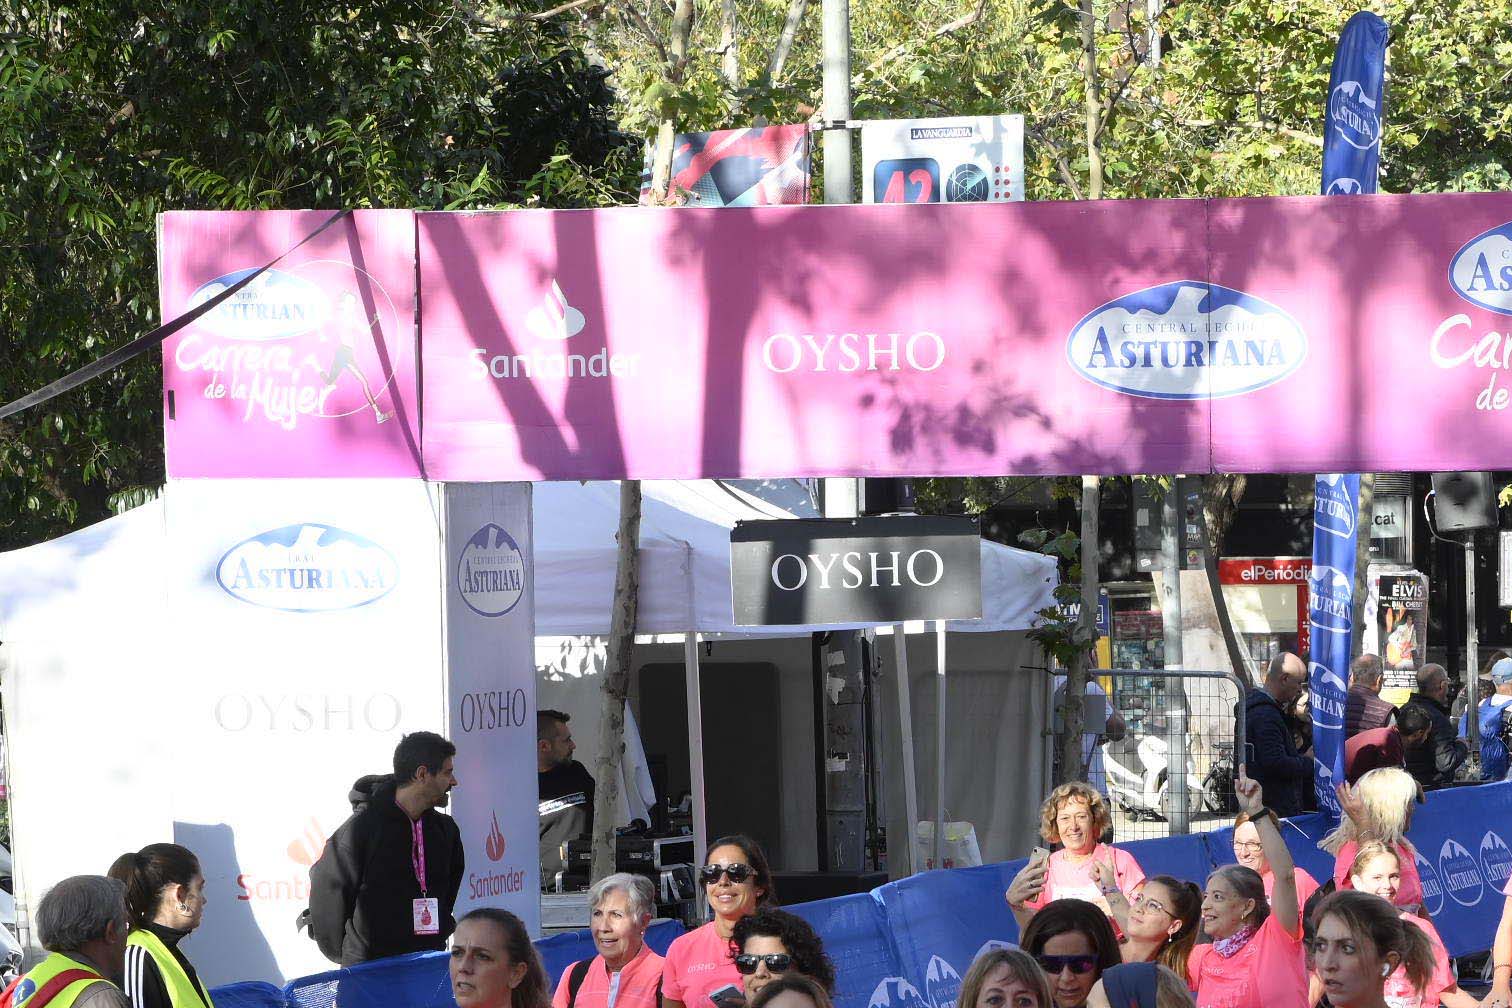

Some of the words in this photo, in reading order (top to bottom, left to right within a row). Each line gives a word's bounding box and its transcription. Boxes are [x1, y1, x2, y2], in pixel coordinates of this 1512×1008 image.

[921, 127, 972, 138] VANGUARDIA
[1122, 322, 1198, 333] CENTRAL
[468, 347, 641, 379] Santander
[762, 331, 946, 374] OYSHO
[1086, 326, 1288, 368] ASTURIANA
[1476, 372, 1510, 411] de
[231, 555, 386, 590] ASTURIANA
[462, 558, 521, 594] ASTURIANA
[770, 549, 945, 591] OYSHO
[1392, 584, 1423, 598] ELVIS
[213, 691, 402, 732] OYSHO
[461, 688, 526, 732] OYSHO
[236, 873, 312, 901] Sant
[469, 867, 525, 900] Santander
